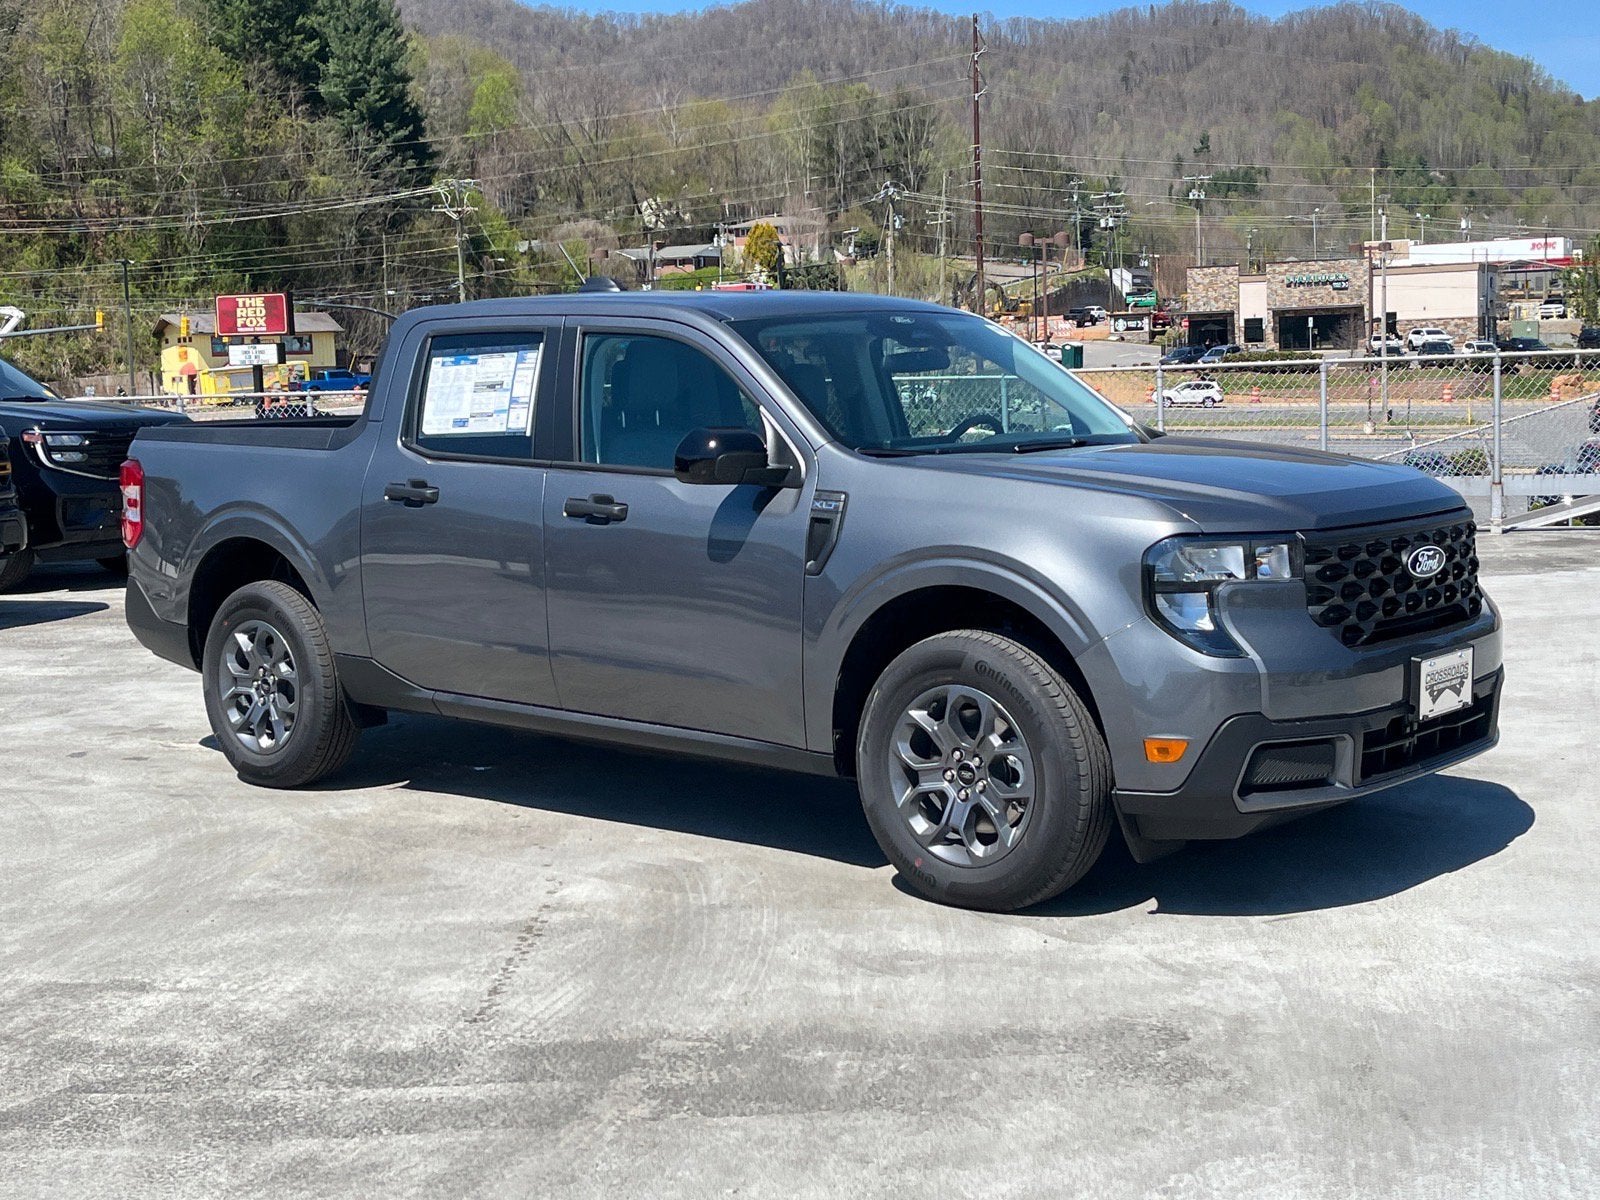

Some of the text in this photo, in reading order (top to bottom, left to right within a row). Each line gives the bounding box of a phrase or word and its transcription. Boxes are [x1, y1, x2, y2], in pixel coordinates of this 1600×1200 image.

[1286, 273, 1349, 284] STARBUCKS
[236, 297, 265, 308] THE
[236, 308, 266, 317] RED
[236, 316, 267, 327] FOX
[813, 500, 839, 509] XLT
[1415, 551, 1440, 573] Ford
